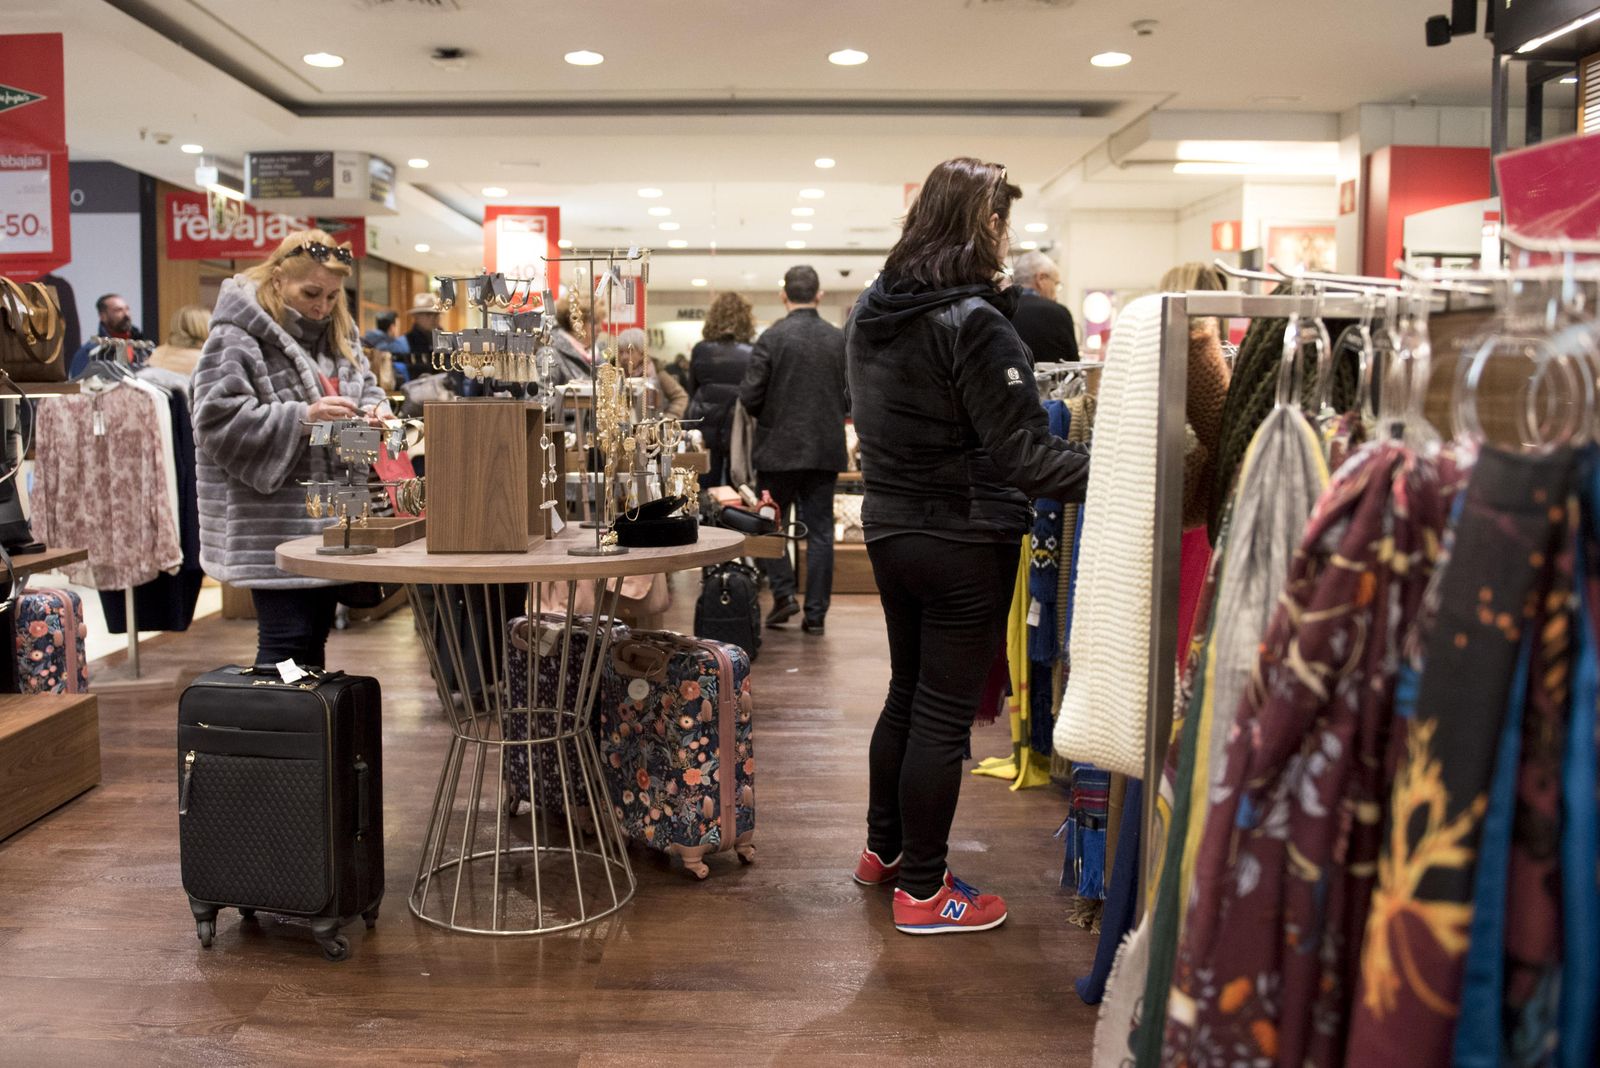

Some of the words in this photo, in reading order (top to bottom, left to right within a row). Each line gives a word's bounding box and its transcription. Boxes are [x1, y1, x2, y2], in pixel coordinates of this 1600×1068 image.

[0, 154, 42, 170] ebajas
[173, 201, 199, 215] Las
[173, 212, 309, 247] rebajas
[940, 898, 968, 921] N
